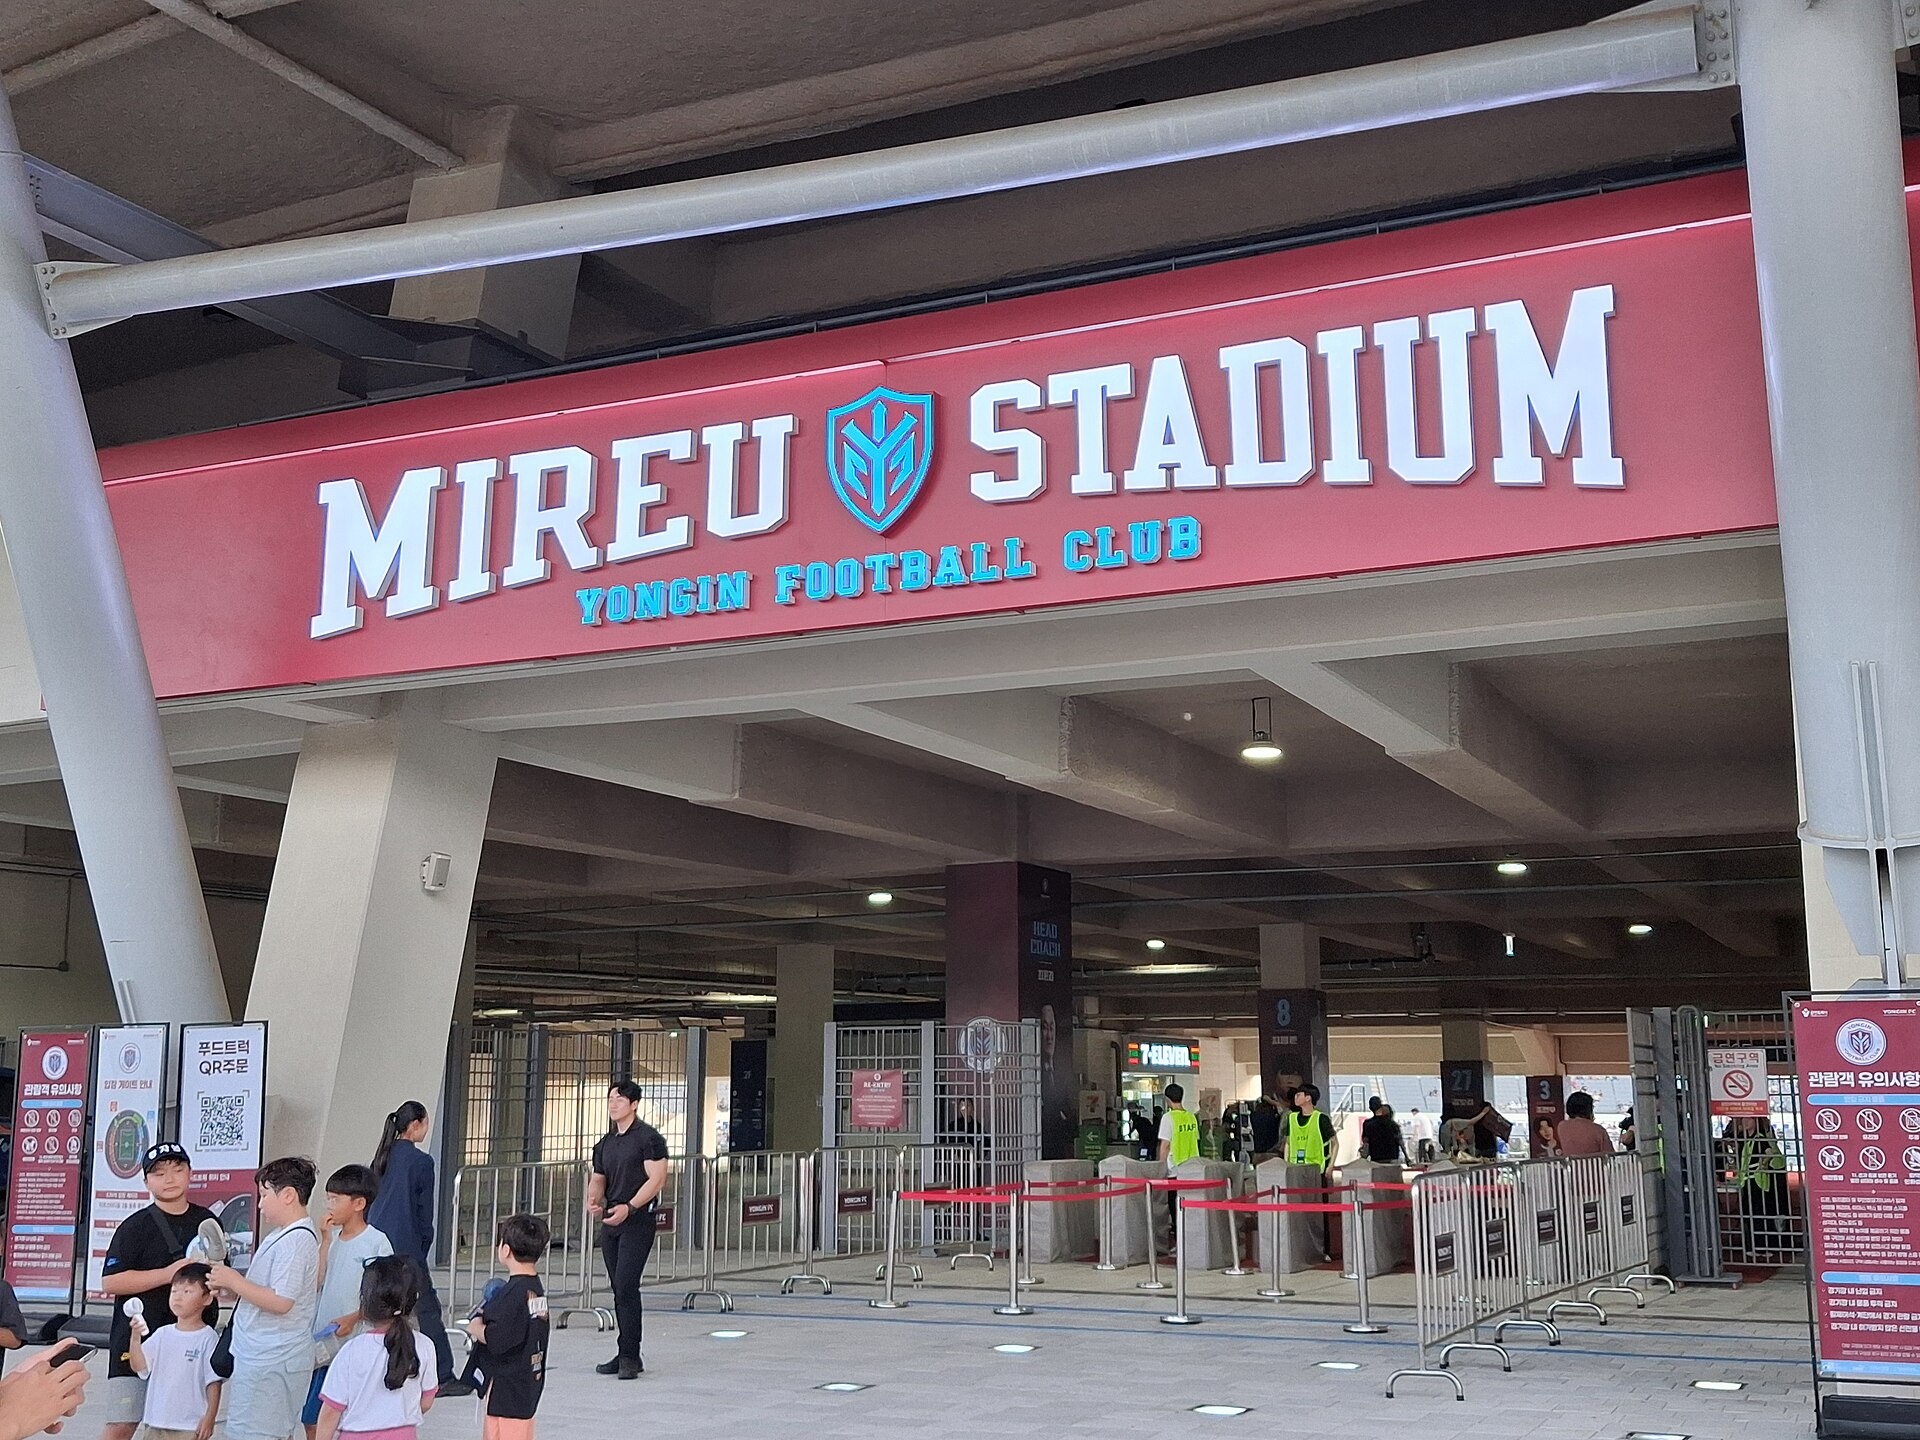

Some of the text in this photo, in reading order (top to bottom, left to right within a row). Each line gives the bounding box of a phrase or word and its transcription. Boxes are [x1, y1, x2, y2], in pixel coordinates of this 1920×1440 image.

[309, 283, 1627, 641] MIREU STADIUM
[575, 514, 1203, 626] YONGIN FOOTBALL CLUB
[1033, 920, 1058, 939] HEAD
[1030, 938, 1061, 957] COACH
[1276, 998, 1291, 1027] 8
[198, 1039, 250, 1055] 푸드트럭
[198, 1058, 250, 1076] QR주문
[1712, 1052, 1759, 1064] 금연구역
[50, 1083, 83, 1096] 유의사항
[1808, 1071, 1920, 1089] 관람객 유의사항
[1539, 1080, 1552, 1101] 3
